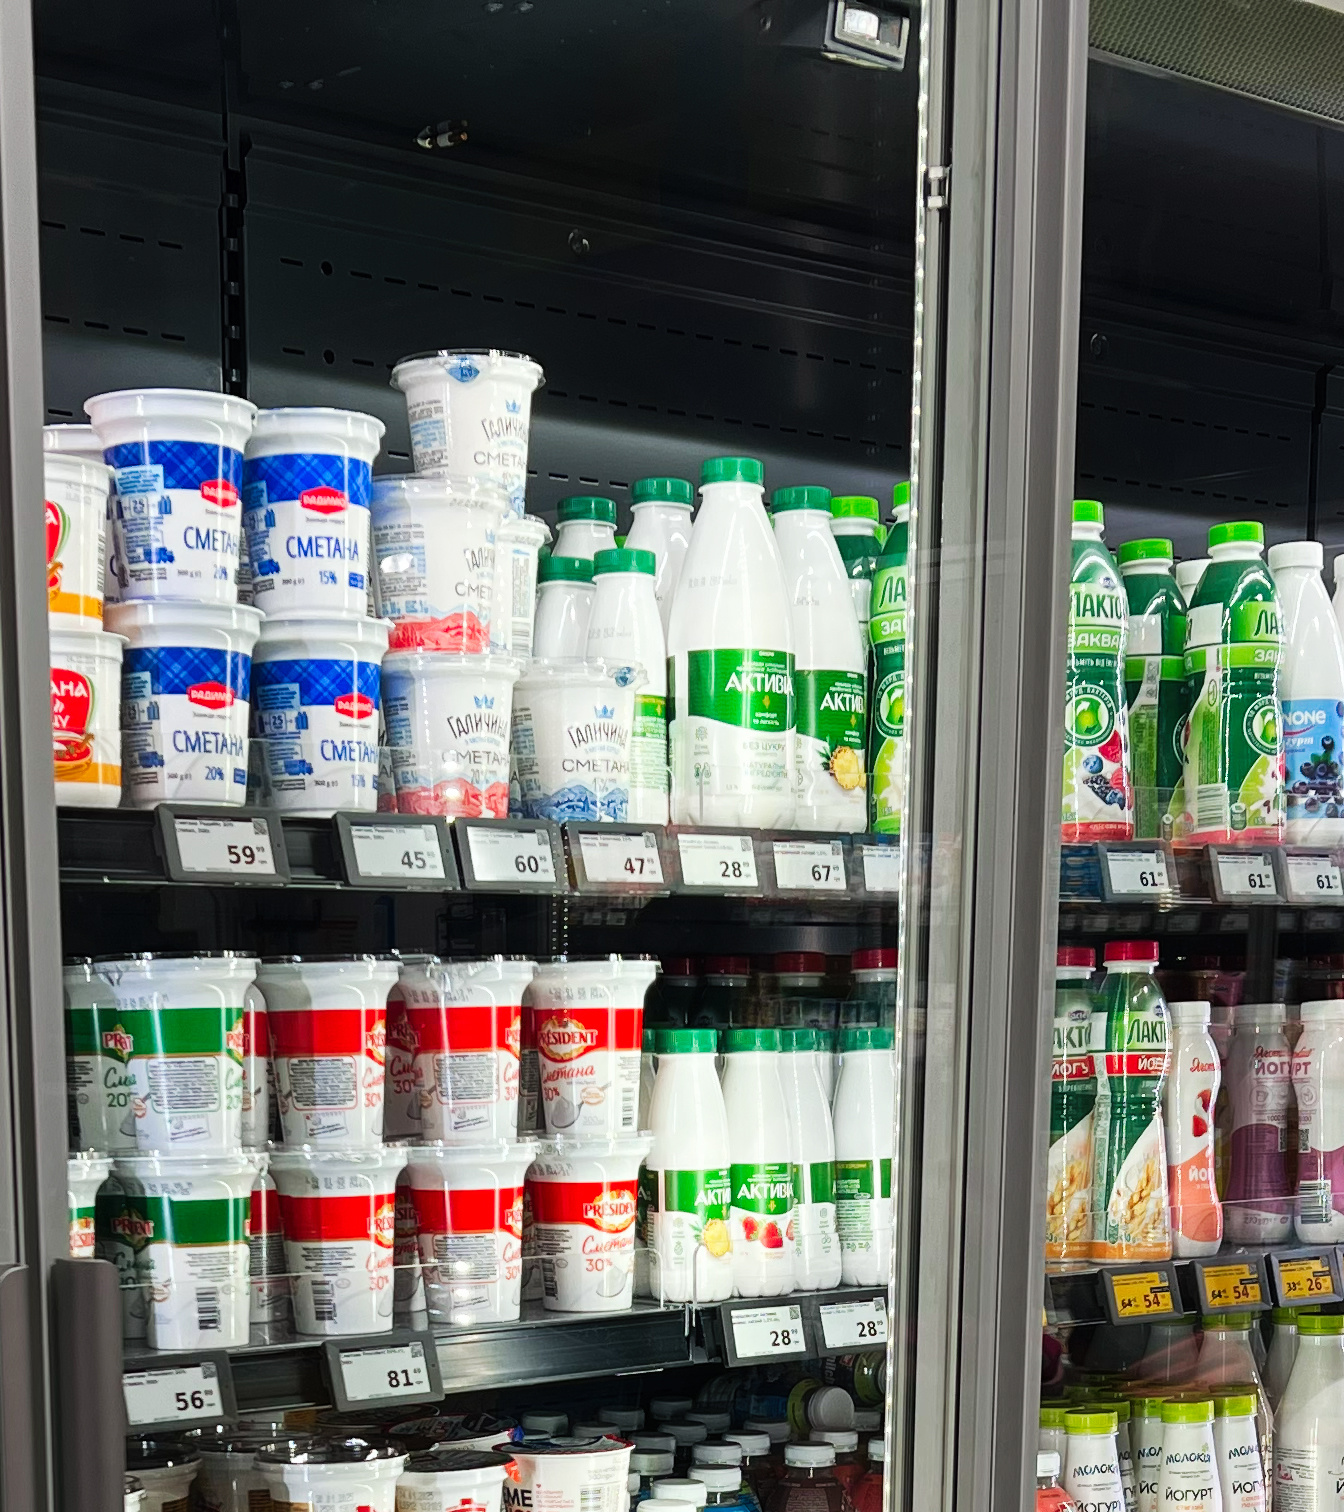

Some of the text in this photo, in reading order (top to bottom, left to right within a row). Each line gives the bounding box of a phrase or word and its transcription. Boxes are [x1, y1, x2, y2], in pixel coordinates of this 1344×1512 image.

[286, 535, 360, 564] СМЕТАНА
[319, 570, 337, 584] 15%
[173, 730, 245, 757] СМЕТАНА
[205, 765, 224, 782] 20%
[227, 844, 255, 866] 59
[401, 850, 426, 870] 45
[514, 854, 539, 874] 60
[623, 858, 646, 876] 47
[719, 862, 742, 879] 28
[811, 864, 831, 882] 67
[1139, 871, 1157, 888] 61
[1248, 873, 1264, 889] 61
[585, 1257, 614, 1273] 30%
[1307, 1277, 1323, 1293] 26
[769, 1330, 791, 1348] 28
[856, 1321, 878, 1339] 28
[387, 1369, 413, 1389] 81
[175, 1390, 204, 1412] 56
[1165, 1485, 1214, 1503] ЙОГУРТ
